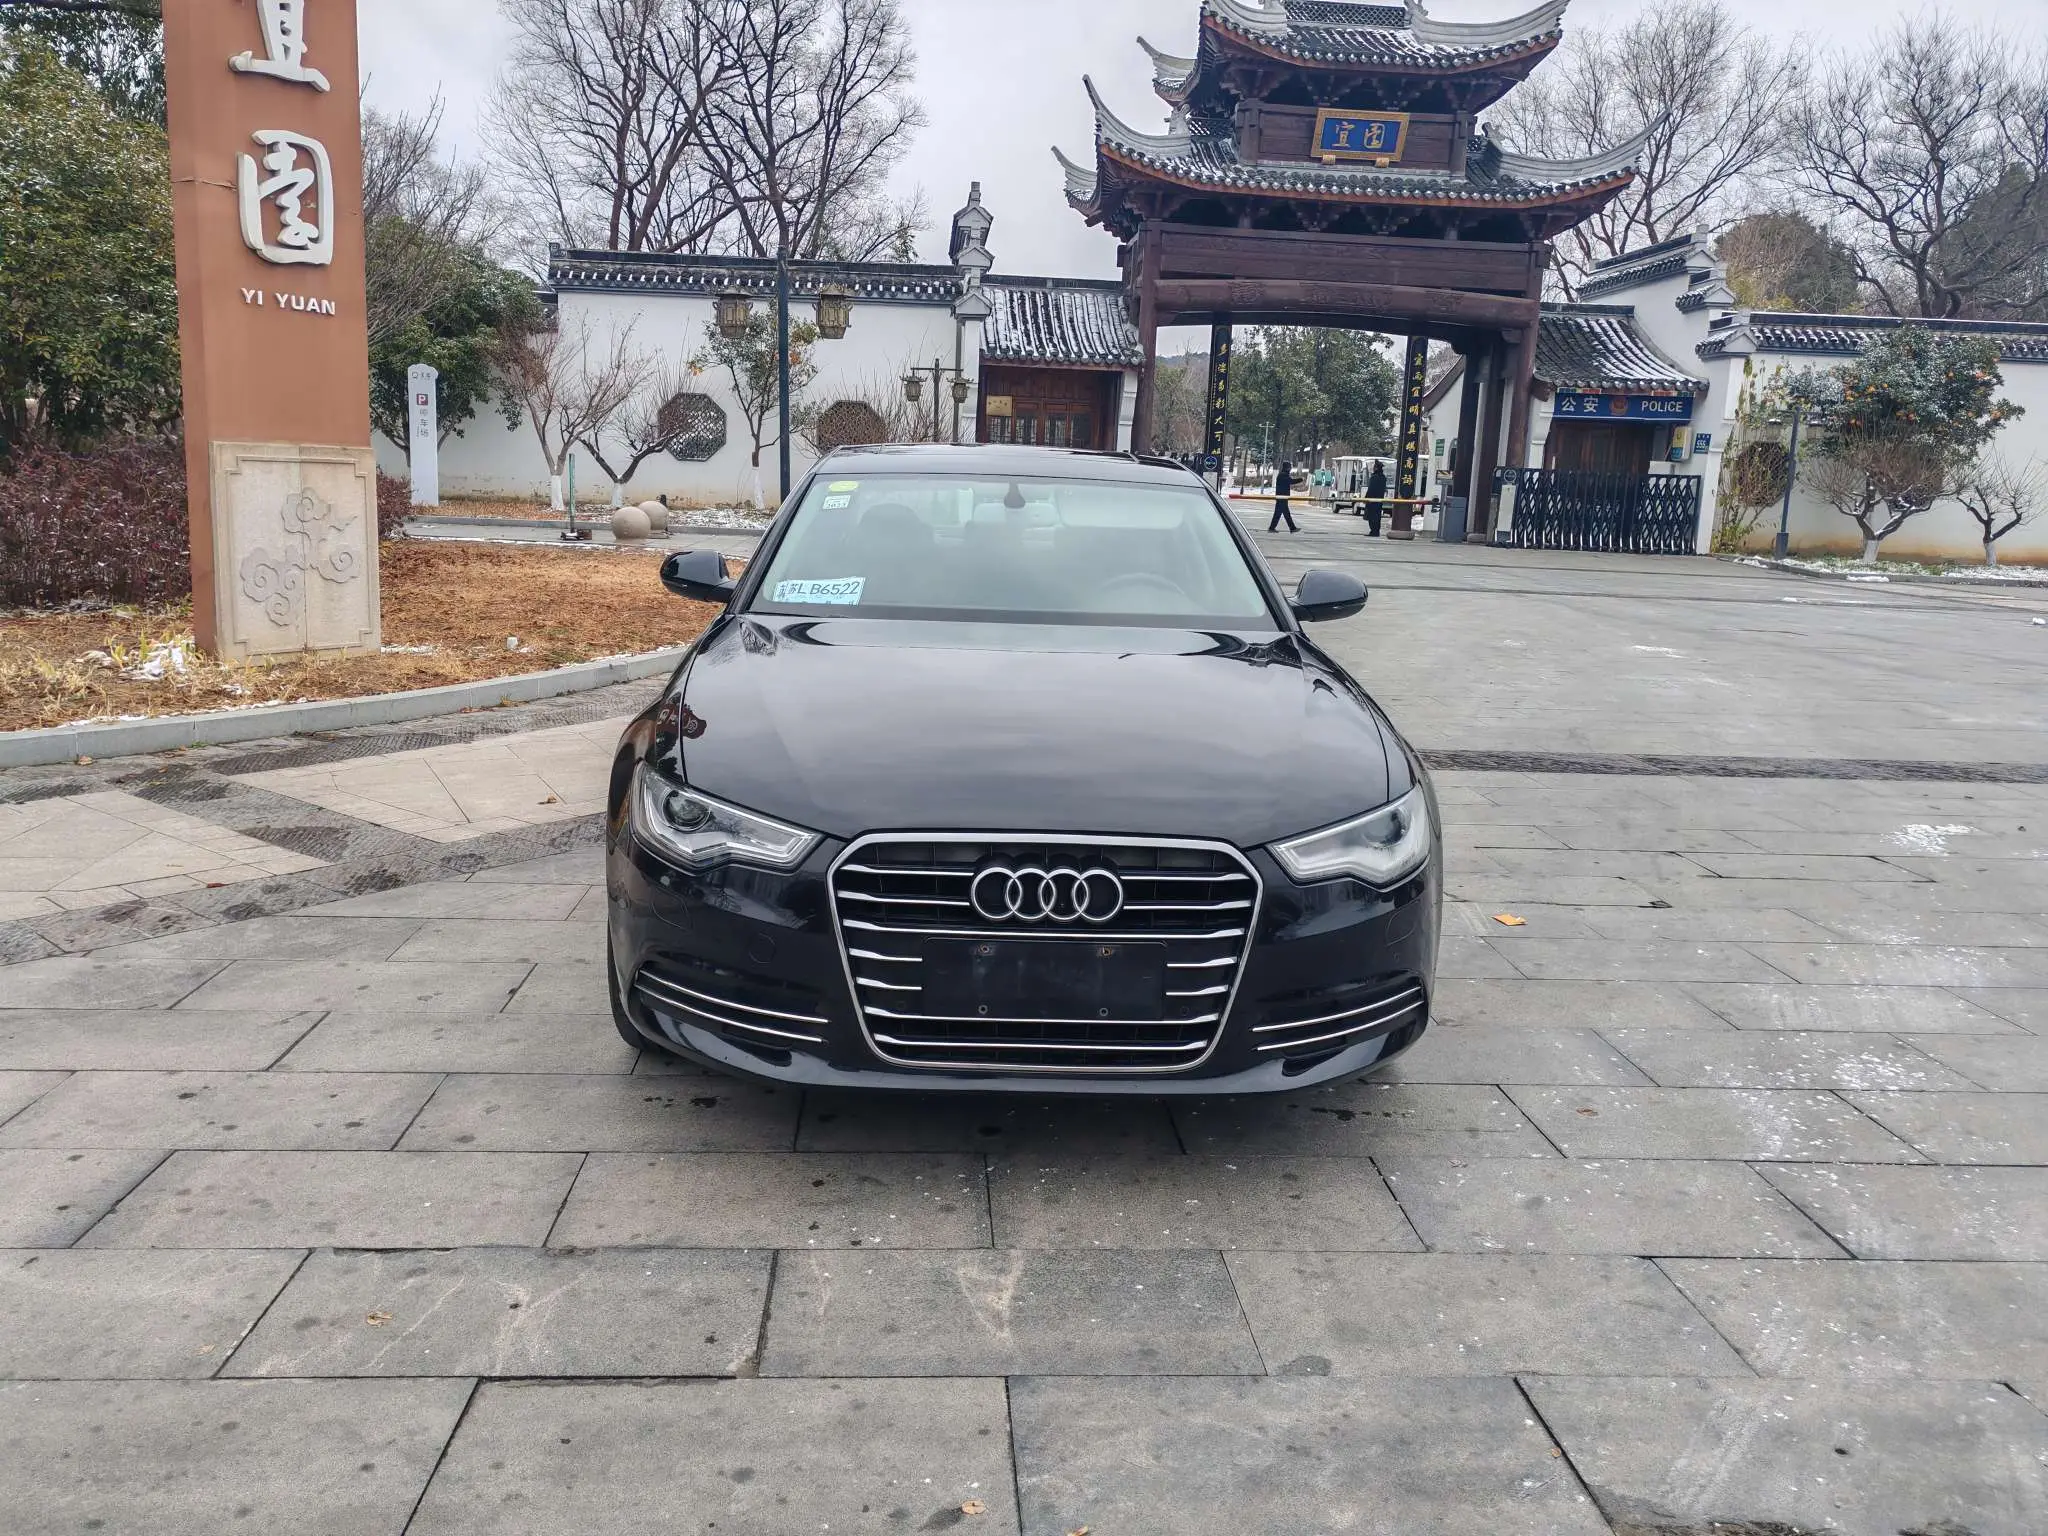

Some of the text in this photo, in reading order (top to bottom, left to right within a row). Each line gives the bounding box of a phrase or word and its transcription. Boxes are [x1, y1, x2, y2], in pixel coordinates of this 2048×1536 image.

[241, 287, 336, 316] YI YUAN
[1561, 397, 1683, 413] 公安 POLICE
